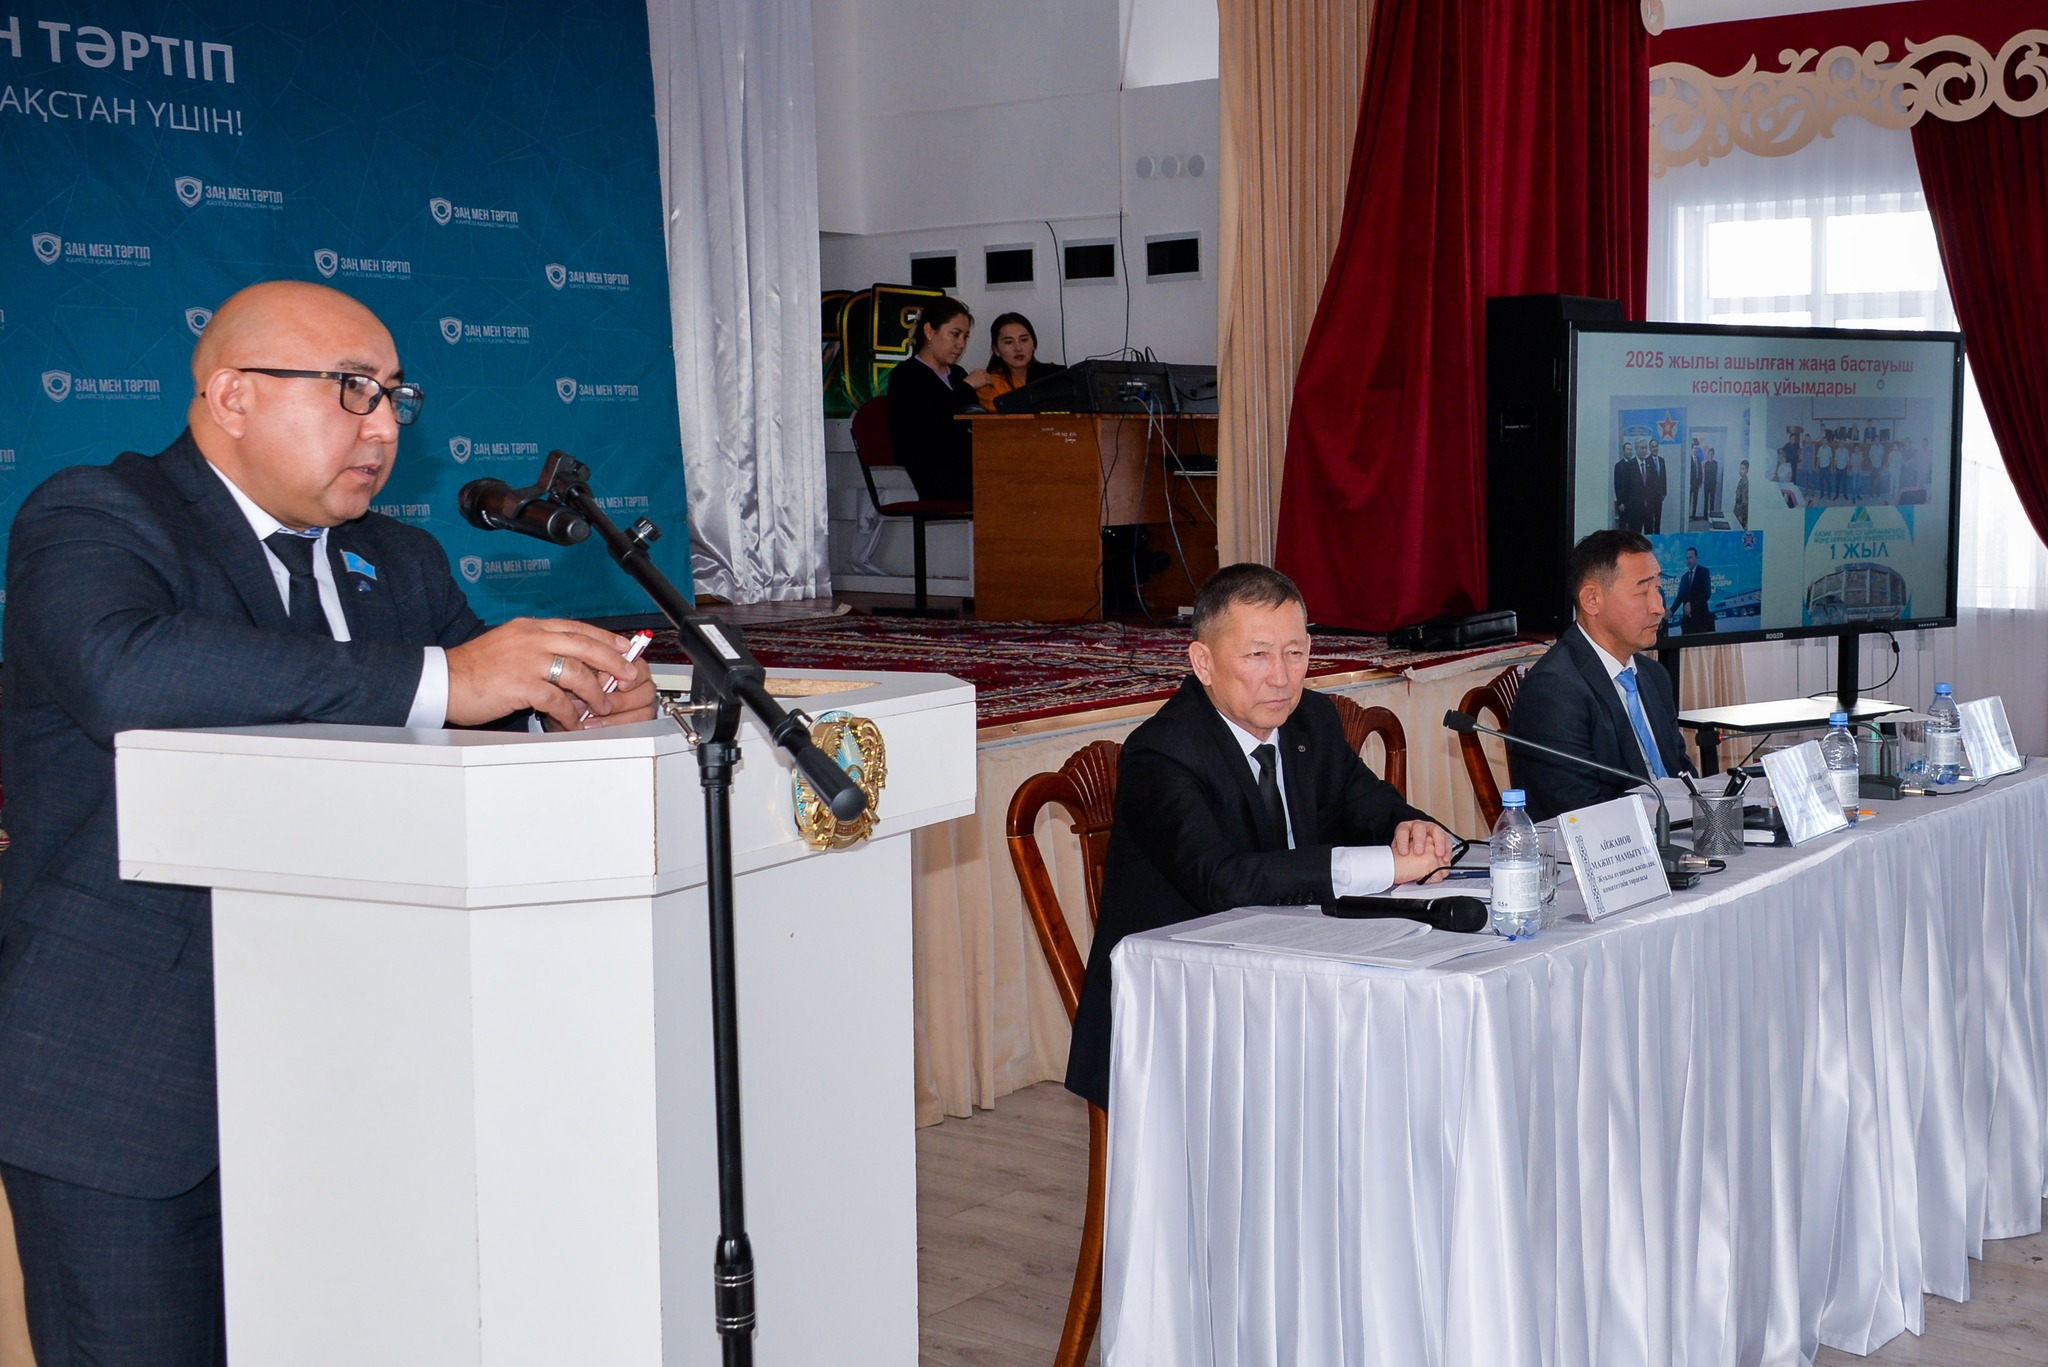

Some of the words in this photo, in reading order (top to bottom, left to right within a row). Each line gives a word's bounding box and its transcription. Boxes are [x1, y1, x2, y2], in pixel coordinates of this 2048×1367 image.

[38, 20, 235, 84] ТӘРТІП
[146, 100, 243, 136] ҮШІН!
[205, 185, 227, 201] ЗАҢ
[228, 187, 250, 200] МЕН
[251, 189, 284, 204] ТӘРТІП
[453, 206, 471, 220] ЗАҢ
[471, 208, 489, 221] МЕН
[490, 209, 518, 223] ТӘРТІП
[64, 242, 87, 258] ЗАҢ
[89, 243, 112, 257] МЕН
[114, 244, 150, 260] ТӘРТІП
[340, 257, 359, 272] ЗАҢ
[360, 258, 379, 272] МЕН
[381, 260, 411, 274] ТӘРТІП
[568, 271, 585, 284] ЗАҢ
[586, 271, 603, 284] МЕН
[603, 272, 629, 286] ТӘРТІП
[464, 324, 482, 337] ЗАҢ
[483, 325, 501, 337] МЕН
[501, 326, 530, 338] ТӘРТІП
[1625, 350, 1664, 369] 2025
[1668, 355, 1720, 370] жылы
[1724, 355, 1796, 372] ашылған
[1798, 358, 1836, 374] жаңа
[1840, 355, 1914, 376] бастауыш
[75, 378, 97, 393] ЗАҢ
[99, 379, 122, 392] МЕН
[123, 379, 160, 393] ТӘРТІП
[578, 384, 595, 396] ЗАҢ
[595, 384, 613, 396] МЕН
[613, 385, 639, 396] ТӘРТІП
[1692, 375, 1769, 396] кәсіподақ
[1773, 377, 1857, 398] ұйымдары
[473, 443, 491, 456] ЗАҢ
[492, 443, 510, 455] МЕН
[511, 442, 538, 455] ТӘРТІП
[400, 503, 431, 516] ТӘРТІП
[606, 496, 624, 508] МЕН
[1830, 543, 1836, 560] 1
[1842, 542, 1889, 559] ЖЫЛ
[484, 561, 502, 574] ЗАҢ
[503, 560, 521, 573] МЕН
[523, 559, 551, 571] ТӘРТІП
[1599, 835, 1632, 851] АЙЖАНОВ
